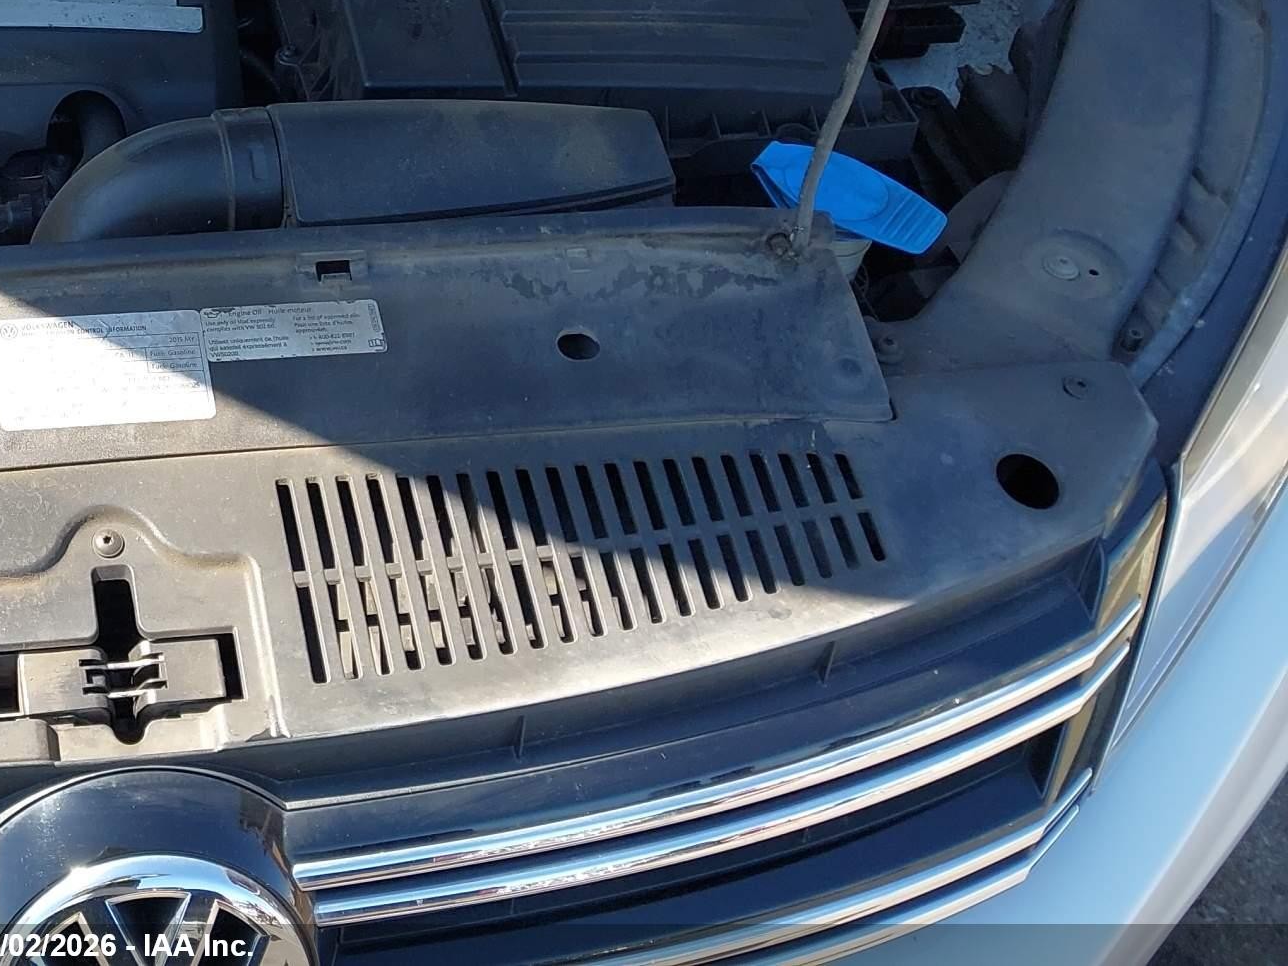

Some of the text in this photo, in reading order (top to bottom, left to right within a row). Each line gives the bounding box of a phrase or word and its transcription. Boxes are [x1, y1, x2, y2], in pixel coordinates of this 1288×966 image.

[228, 310, 251, 318] Engine
[21, 320, 74, 331] VOLKSWAGEN
[167, 348, 196, 356] Gasoline
